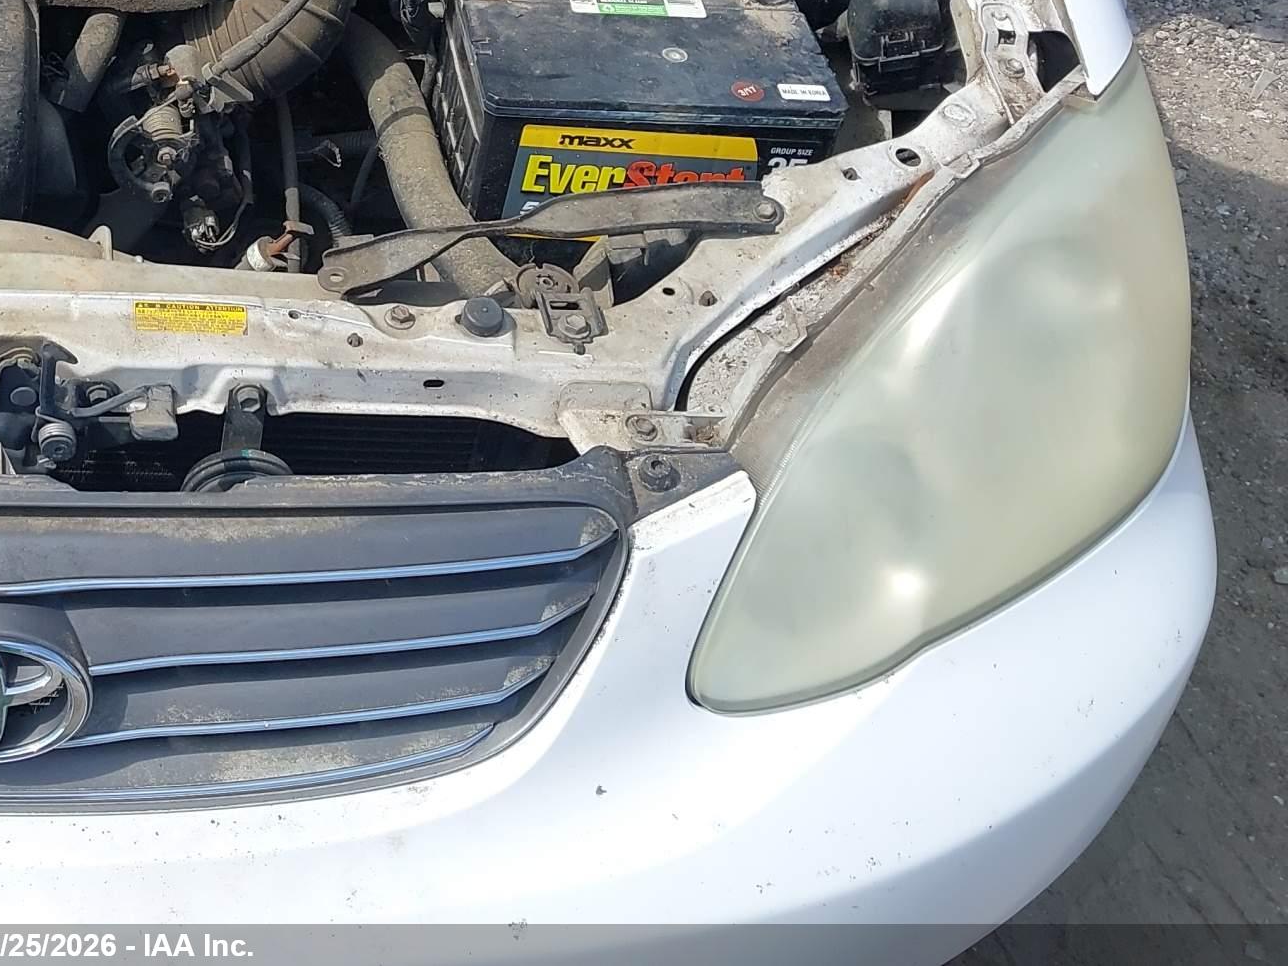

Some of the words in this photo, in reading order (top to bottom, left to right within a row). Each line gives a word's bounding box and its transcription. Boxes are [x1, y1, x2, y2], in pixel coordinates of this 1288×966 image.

[559, 134, 636, 150] maxx
[770, 147, 797, 155] GROUP
[797, 148, 814, 156] SIZE
